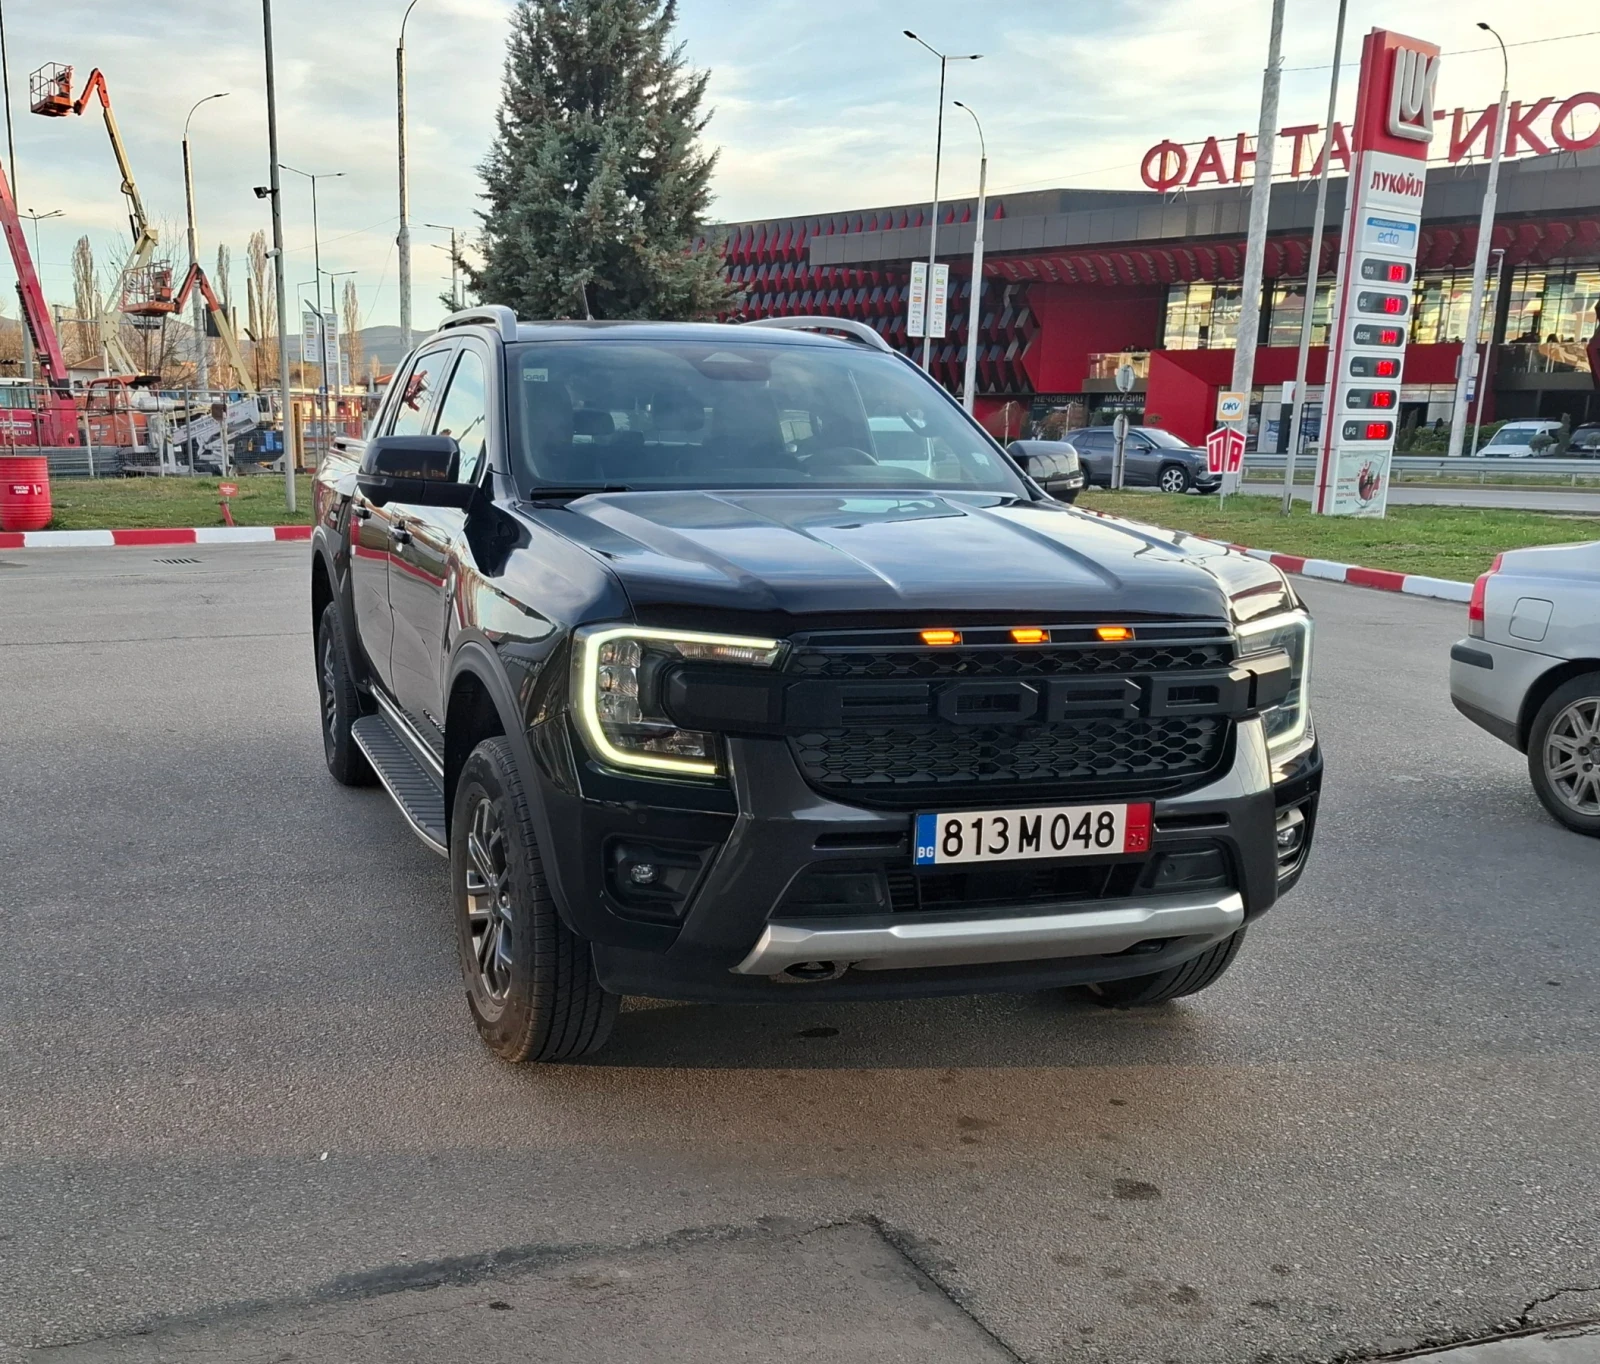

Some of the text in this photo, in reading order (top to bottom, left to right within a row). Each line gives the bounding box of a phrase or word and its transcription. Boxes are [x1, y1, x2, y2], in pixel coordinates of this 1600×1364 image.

[1370, 171, 1423, 198] ЛУКОЙЛ
[1222, 402, 1241, 411] DKV
[1345, 426, 1357, 436] LPG
[818, 675, 1227, 727] FORD
[917, 846, 934, 859] BG
[1128, 832, 1144, 847] 26
